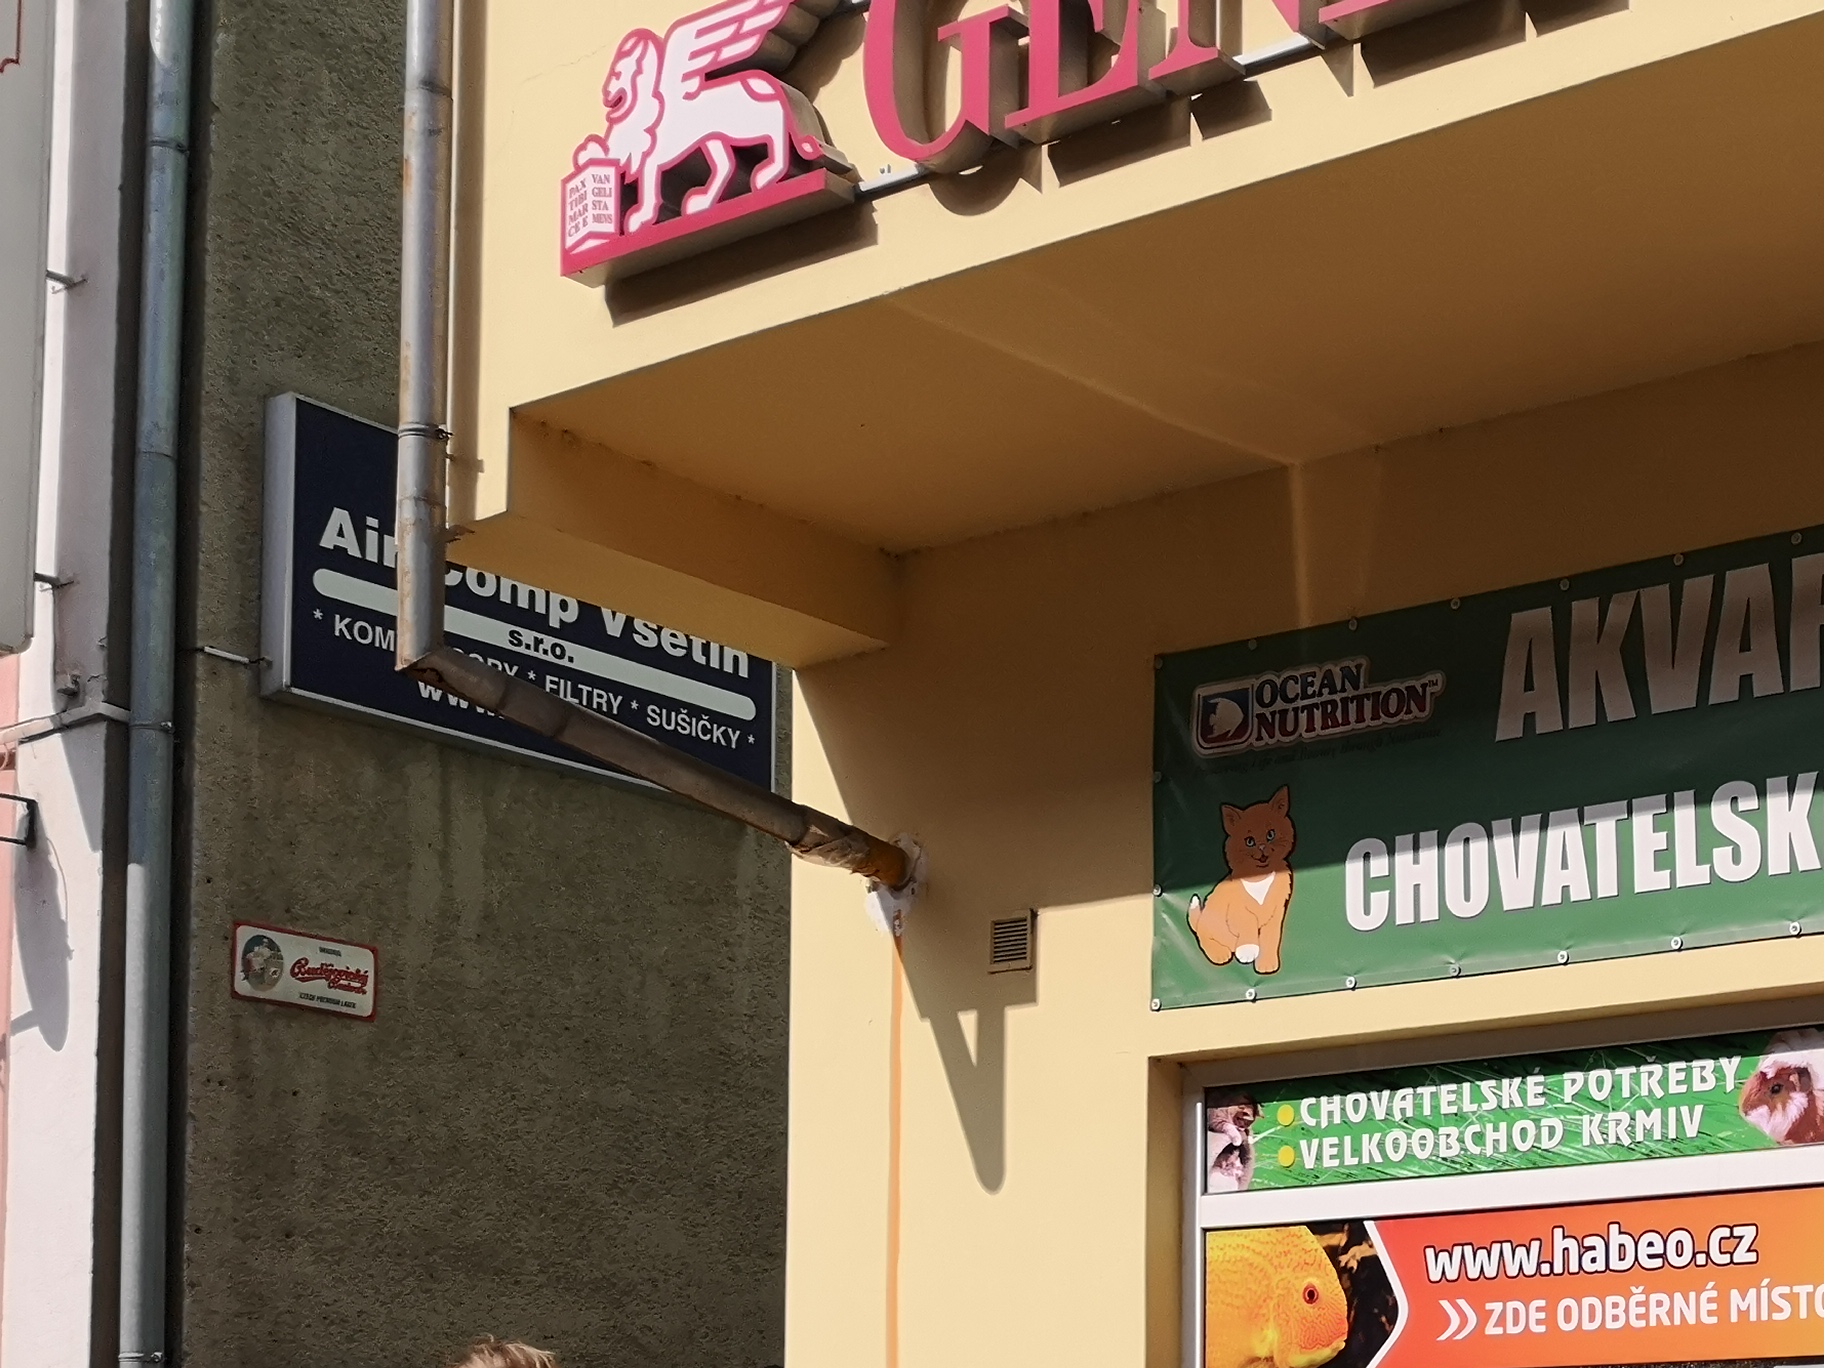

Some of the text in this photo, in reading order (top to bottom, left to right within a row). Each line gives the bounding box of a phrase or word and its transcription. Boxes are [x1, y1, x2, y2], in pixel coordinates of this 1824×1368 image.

[592, 174, 610, 184] VAN
[592, 187, 612, 197] GELI
[592, 200, 609, 211] STA
[592, 213, 613, 224] MENS
[508, 628, 575, 664] s.r.o.
[1255, 663, 1363, 708] OCEAN
[545, 676, 623, 715] FILTRY
[646, 703, 741, 751] SUŠIČKY
[1299, 1104, 1705, 1170] VELKOOBCHOD KRMIV
[1425, 1221, 1759, 1283] www.habeo.cz
[1484, 1300, 1547, 1336] ZDE
[1556, 1284, 1717, 1331] ODBĚRNÉ
